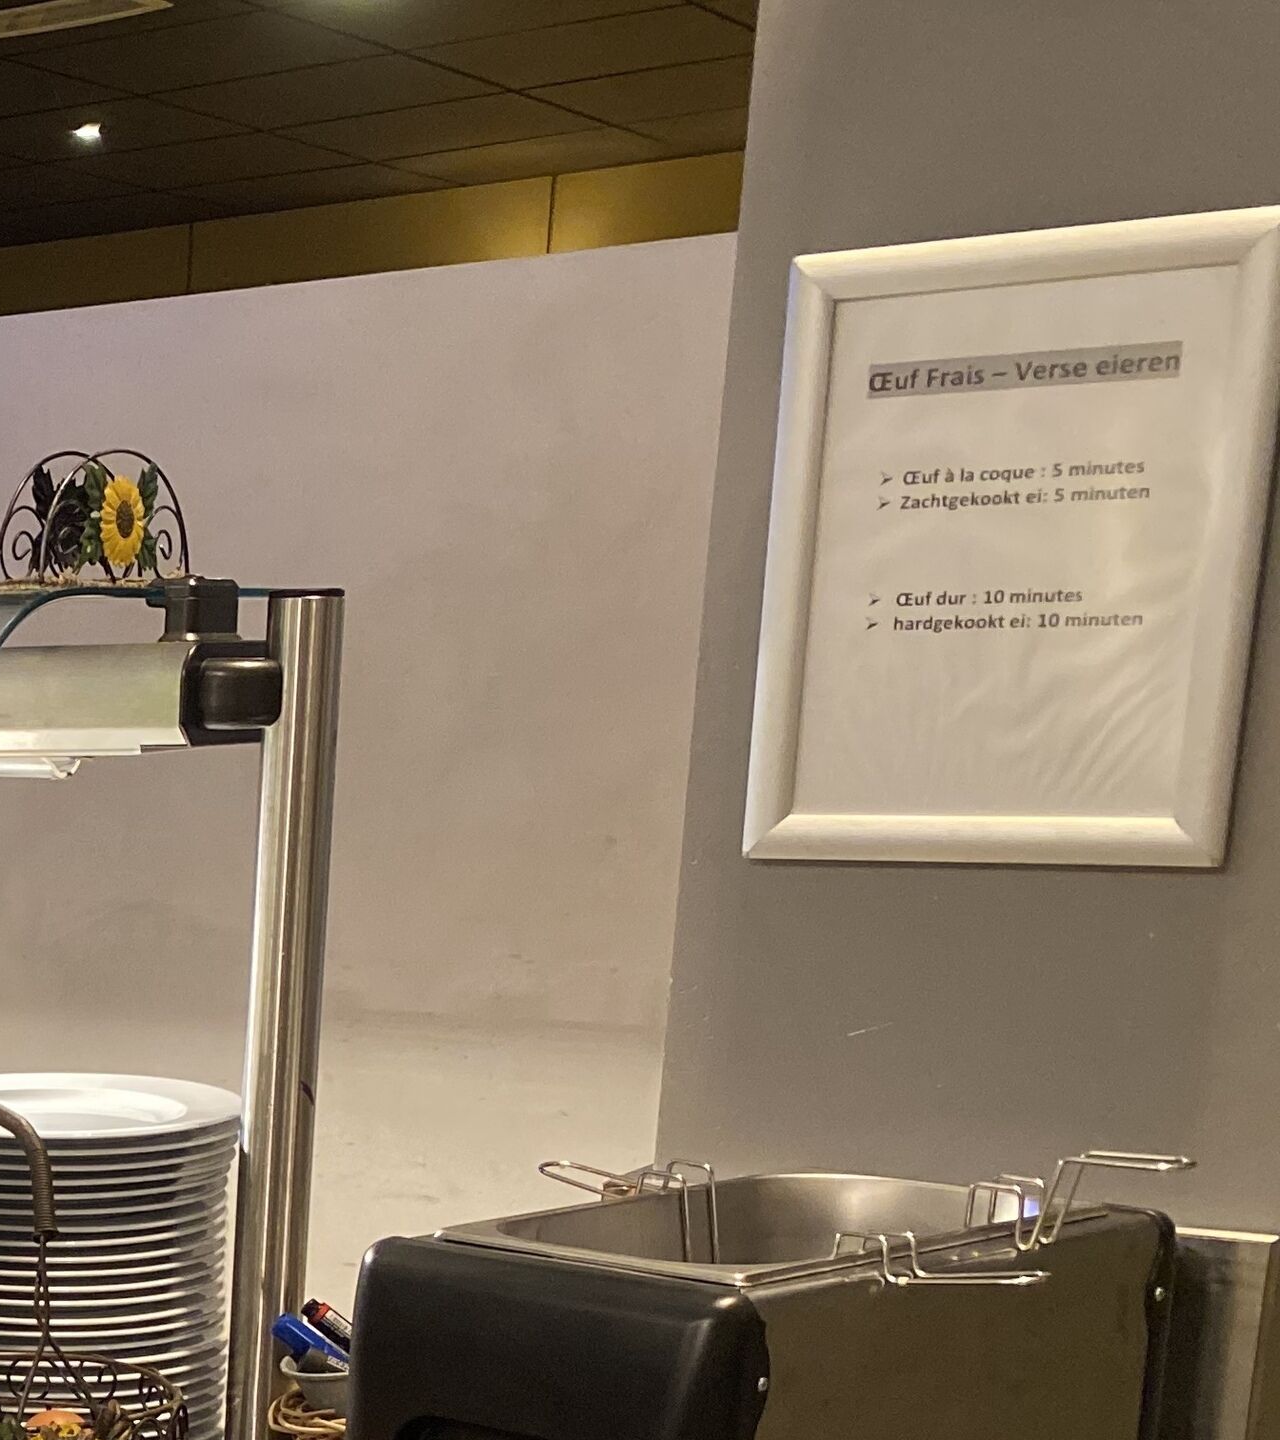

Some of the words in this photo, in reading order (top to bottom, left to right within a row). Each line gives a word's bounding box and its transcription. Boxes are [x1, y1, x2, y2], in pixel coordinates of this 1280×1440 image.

[868, 368, 920, 393] Œuf
[926, 364, 985, 388] Frais
[1015, 360, 1088, 382] Verse
[1095, 353, 1181, 377] eieren
[902, 468, 940, 486] Œuf
[944, 467, 955, 483] à
[960, 467, 975, 483] la
[980, 466, 1035, 487] coque
[1052, 463, 1063, 478] 5
[1068, 459, 1146, 477] minutes
[899, 490, 1020, 511] Zachtgekookt
[1025, 487, 1049, 505] ei:
[1054, 487, 1065, 502] 5
[1071, 484, 1151, 501] minuten
[895, 590, 933, 606] Œuf
[936, 590, 967, 606] dur
[983, 589, 1005, 604] 10
[1009, 587, 1083, 604] minutes
[893, 614, 1006, 634] hardgekookt
[1009, 613, 1033, 629] ei:
[1037, 613, 1060, 629] 10
[1064, 612, 1144, 628] minuten
